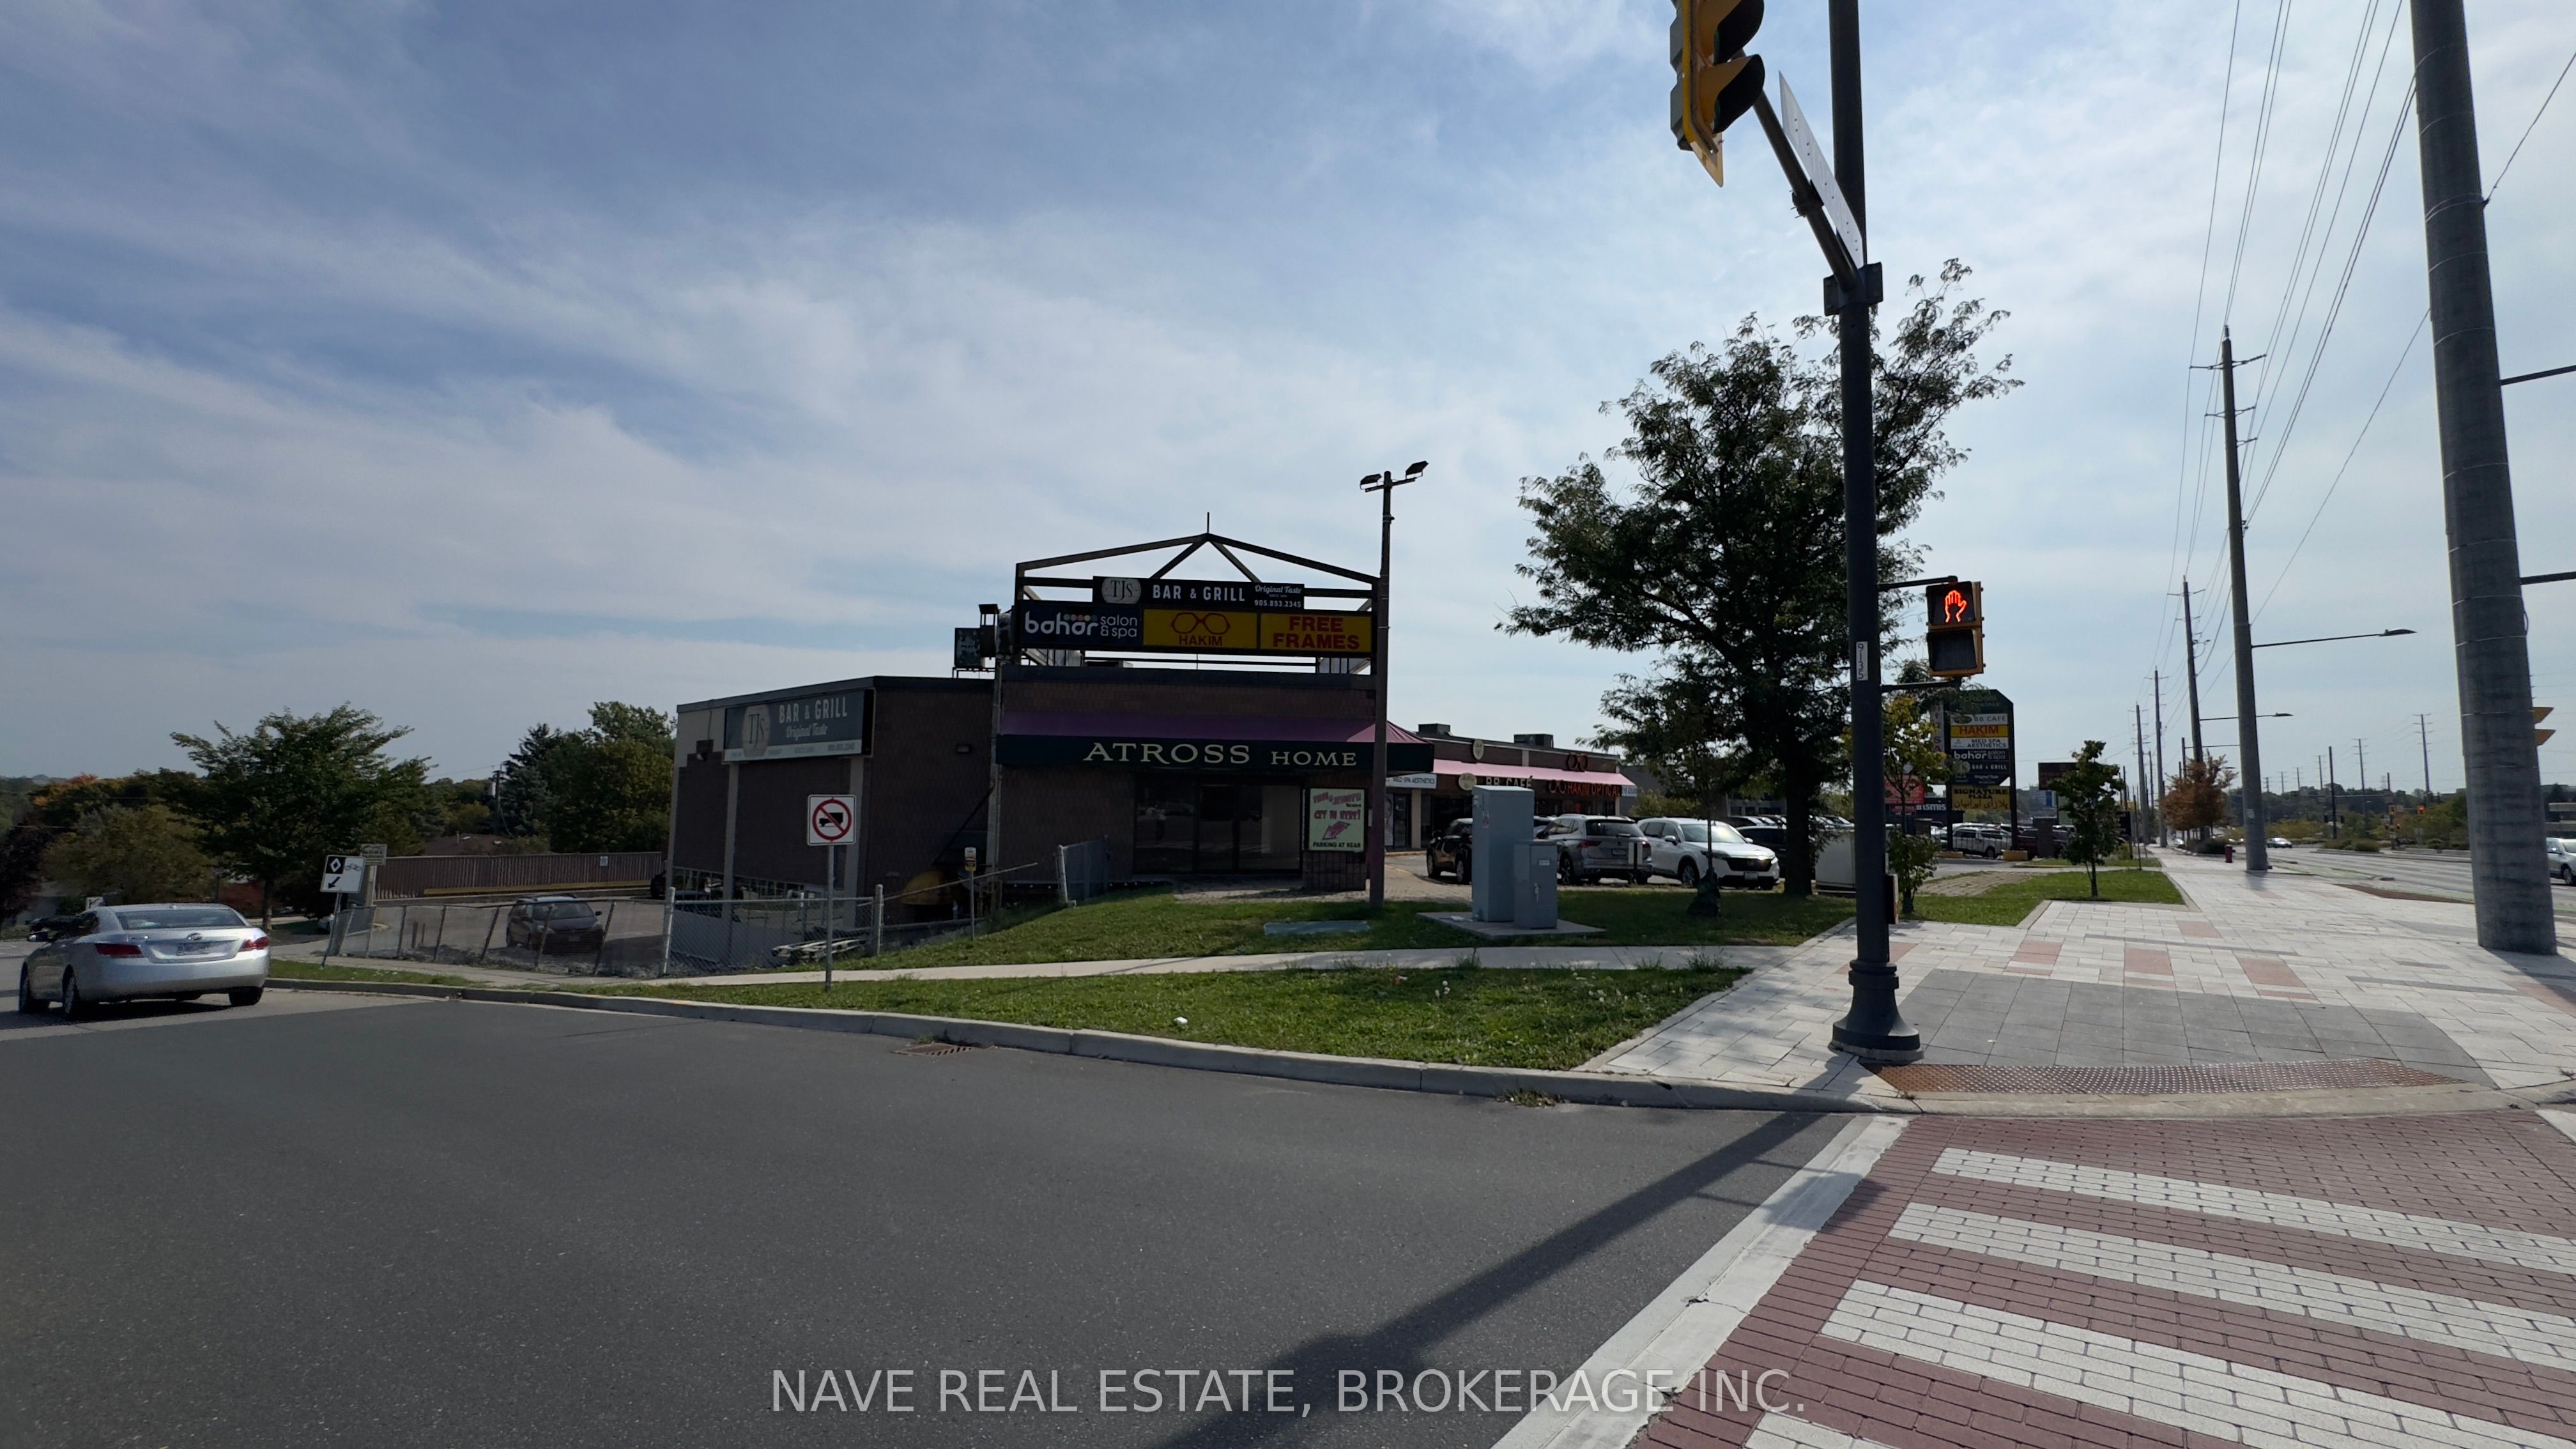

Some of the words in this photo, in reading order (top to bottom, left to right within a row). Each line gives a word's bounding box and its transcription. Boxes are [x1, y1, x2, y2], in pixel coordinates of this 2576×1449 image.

[1153, 585, 1181, 599] BAR
[1190, 588, 1197, 599] &
[1203, 587, 1245, 602] GRILL
[1254, 585, 1284, 594] Original
[1254, 599, 1301, 608] 905.853.2345
[1100, 615, 1137, 627] salon
[1289, 616, 1344, 632] FREE
[1100, 626, 1109, 636] &
[1112, 627, 1137, 638] spa
[1179, 635, 1222, 646] HAKIM
[1273, 632, 1360, 650] FRAMES
[779, 703, 799, 724] BAR
[804, 705, 810, 719] &
[815, 696, 848, 720] GRILL
[1959, 726, 1999, 734] HAKIM
[1084, 742, 1250, 765] ATROSS
[1271, 751, 1357, 766] HOME
